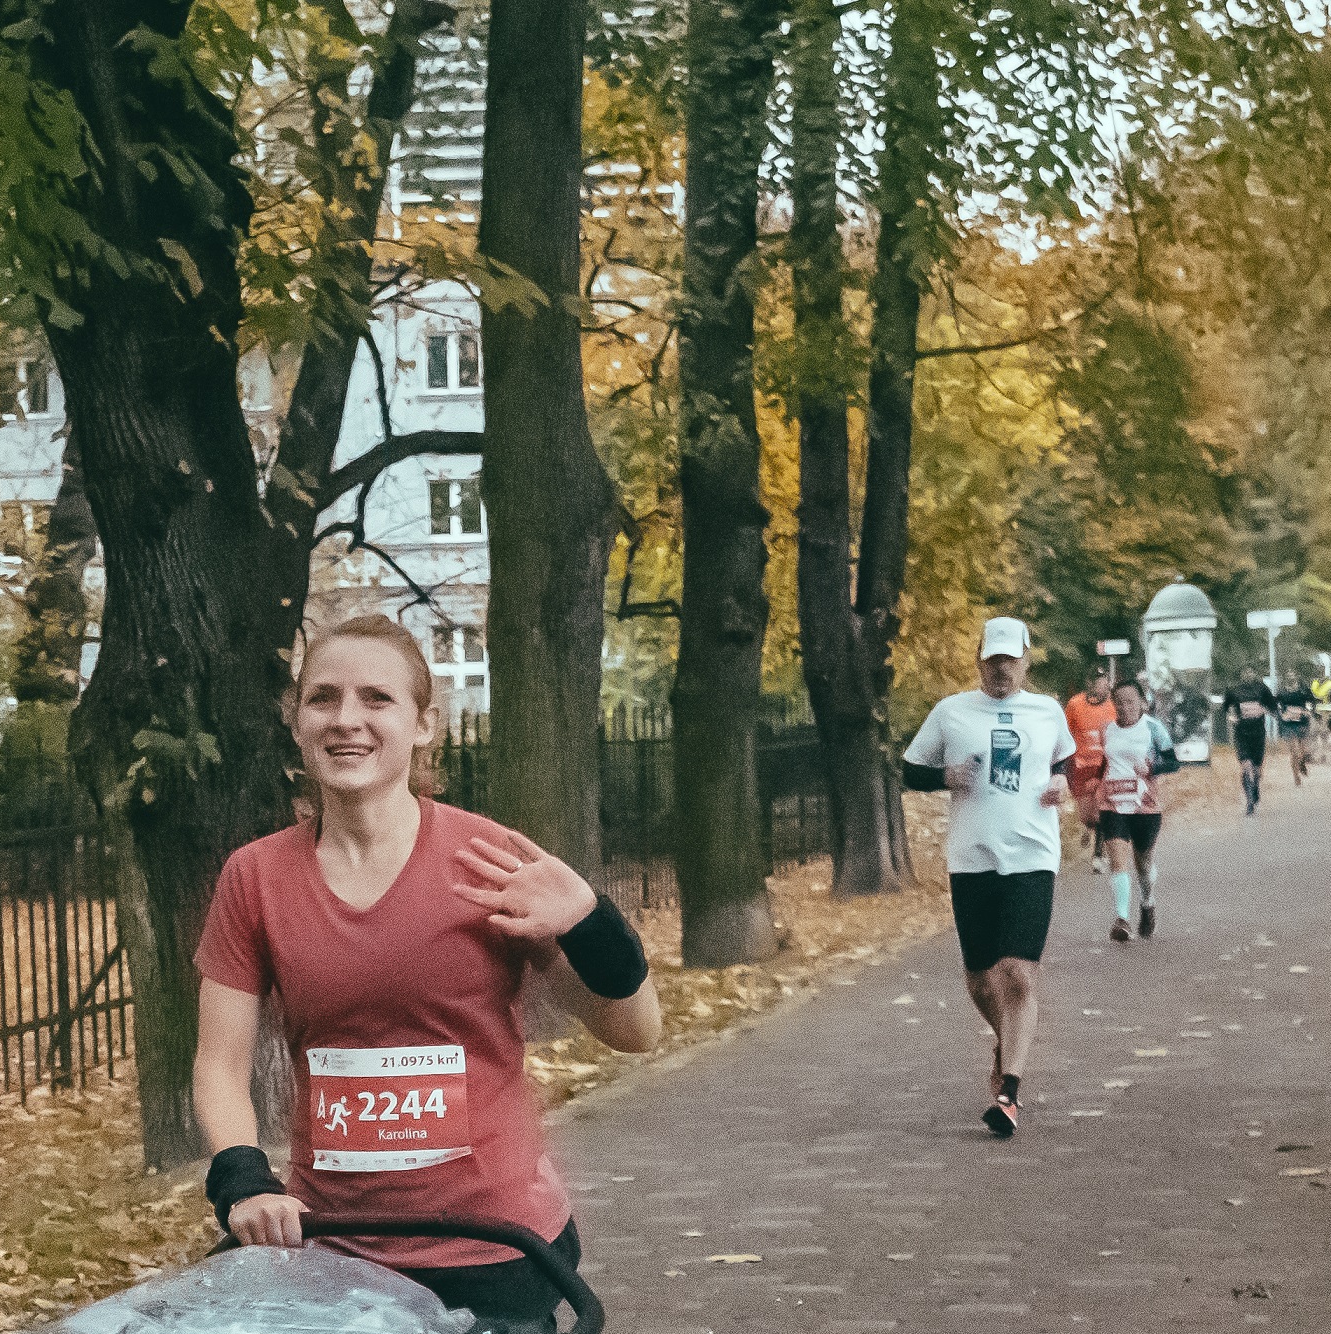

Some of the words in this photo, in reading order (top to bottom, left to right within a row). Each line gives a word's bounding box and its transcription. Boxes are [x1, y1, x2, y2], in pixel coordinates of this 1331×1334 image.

[381, 1055, 434, 1068] 21.0975
[437, 1054, 458, 1065] km
[357, 1088, 447, 1121] 2244
[378, 1127, 428, 1140] Karolina
